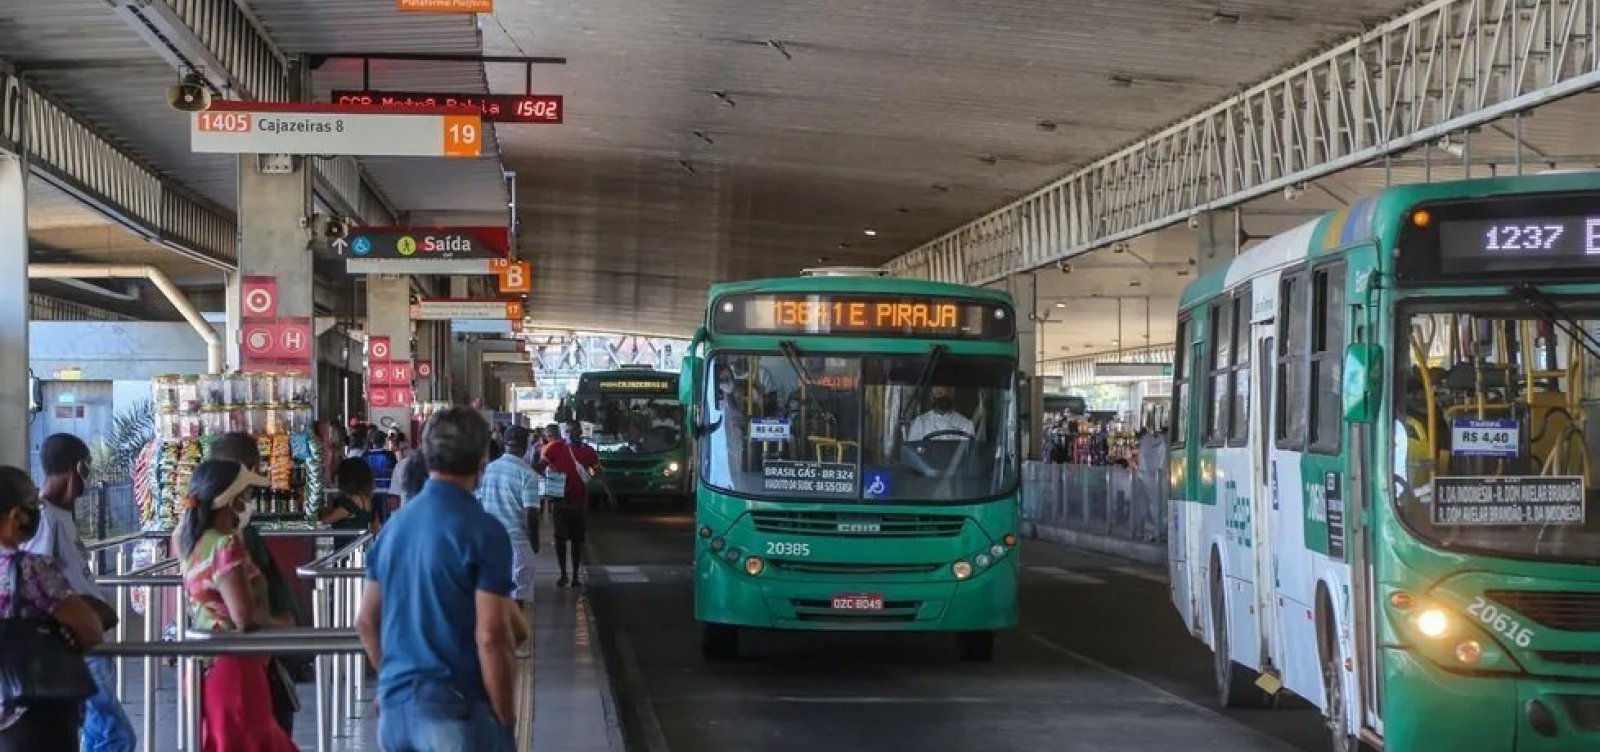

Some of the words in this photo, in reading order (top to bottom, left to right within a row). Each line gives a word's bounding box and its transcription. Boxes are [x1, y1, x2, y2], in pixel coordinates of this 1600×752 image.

[517, 101, 557, 118] 15:02
[202, 115, 248, 131] 1405
[258, 118, 331, 134] Cajazeiras
[336, 120, 344, 133] 8
[449, 124, 476, 144] 19
[424, 236, 471, 252] Saída
[1486, 225, 1564, 250] 1237
[507, 265, 523, 287] B
[876, 303, 956, 328] PIRAJA
[1462, 431, 1478, 442] R$
[1482, 431, 1509, 443] 4,40
[765, 466, 796, 478] BRASIL
[798, 466, 816, 479] GÁS
[822, 470, 835, 479] BR
[836, 470, 854, 480] 324
[766, 542, 811, 556] 20385
[1466, 596, 1535, 647] 20616
